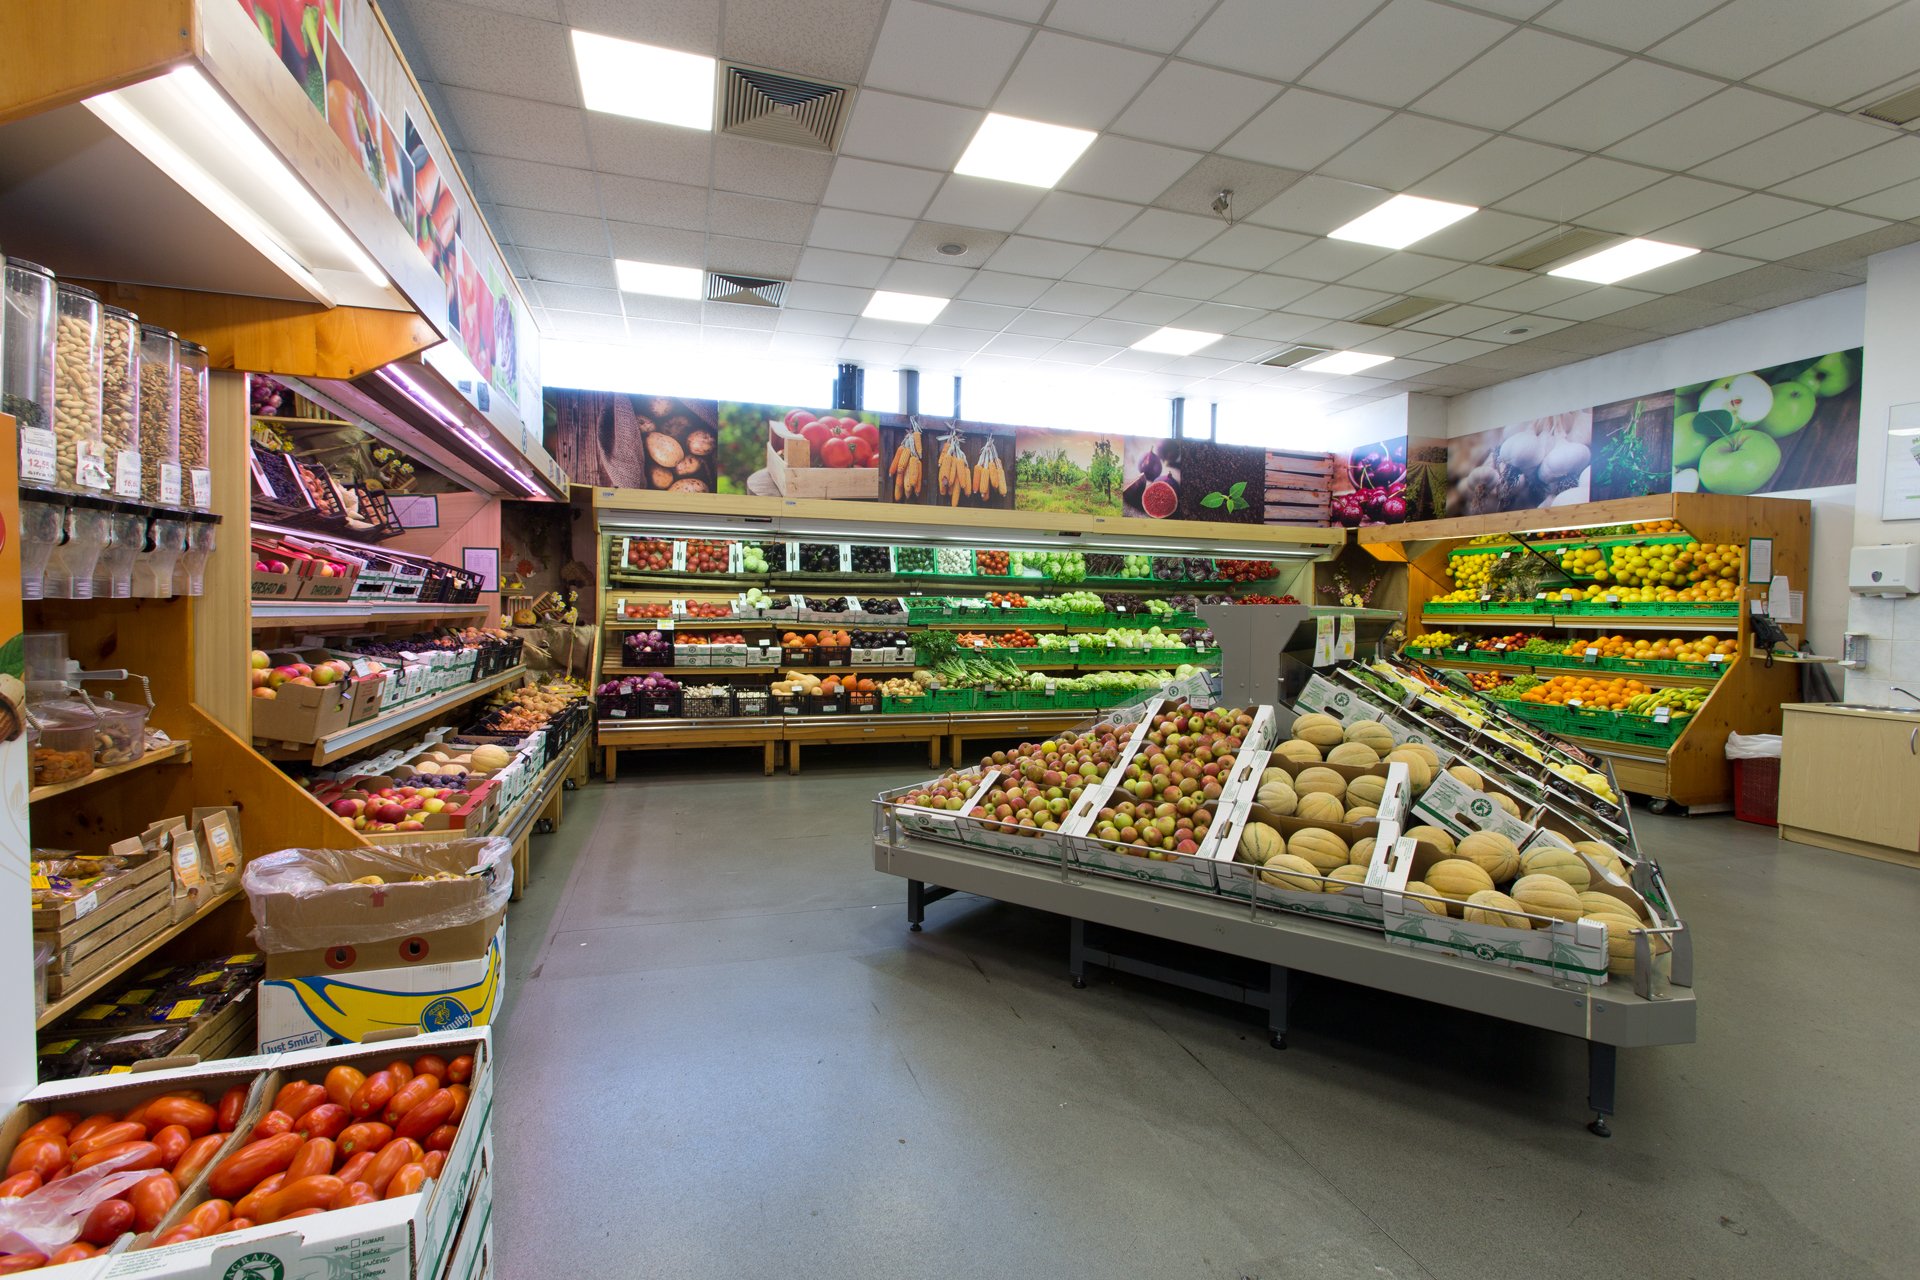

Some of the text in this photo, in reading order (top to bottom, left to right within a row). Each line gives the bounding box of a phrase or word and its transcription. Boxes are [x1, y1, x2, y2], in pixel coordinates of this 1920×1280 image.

[251, 581, 278, 595] ARSAD
[266, 1043, 287, 1055] Just
[361, 1236, 385, 1246] KUMARE
[226, 1253, 281, 1279] AGRARIA
[362, 1256, 391, 1268] JAJČEVEC
